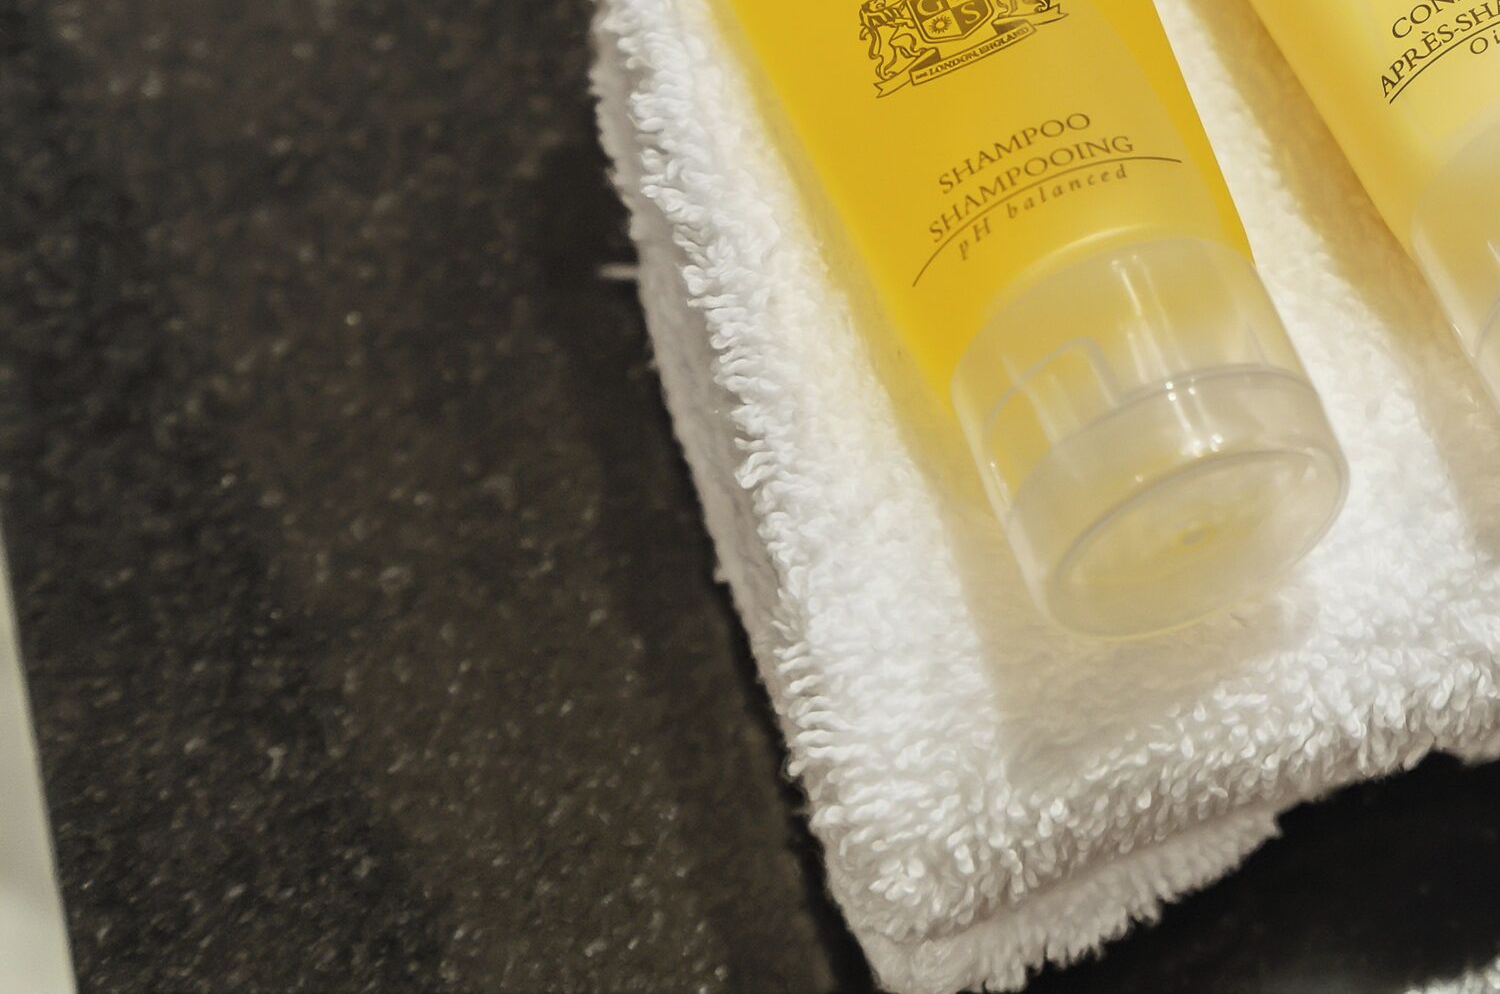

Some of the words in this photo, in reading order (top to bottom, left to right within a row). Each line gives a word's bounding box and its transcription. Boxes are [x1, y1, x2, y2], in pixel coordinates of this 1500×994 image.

[928, 135, 1134, 243] SHAMPOOING
[938, 113, 1091, 195] SHAMPOO
[957, 217, 993, 261] pH
[1006, 163, 1129, 220] balanced
